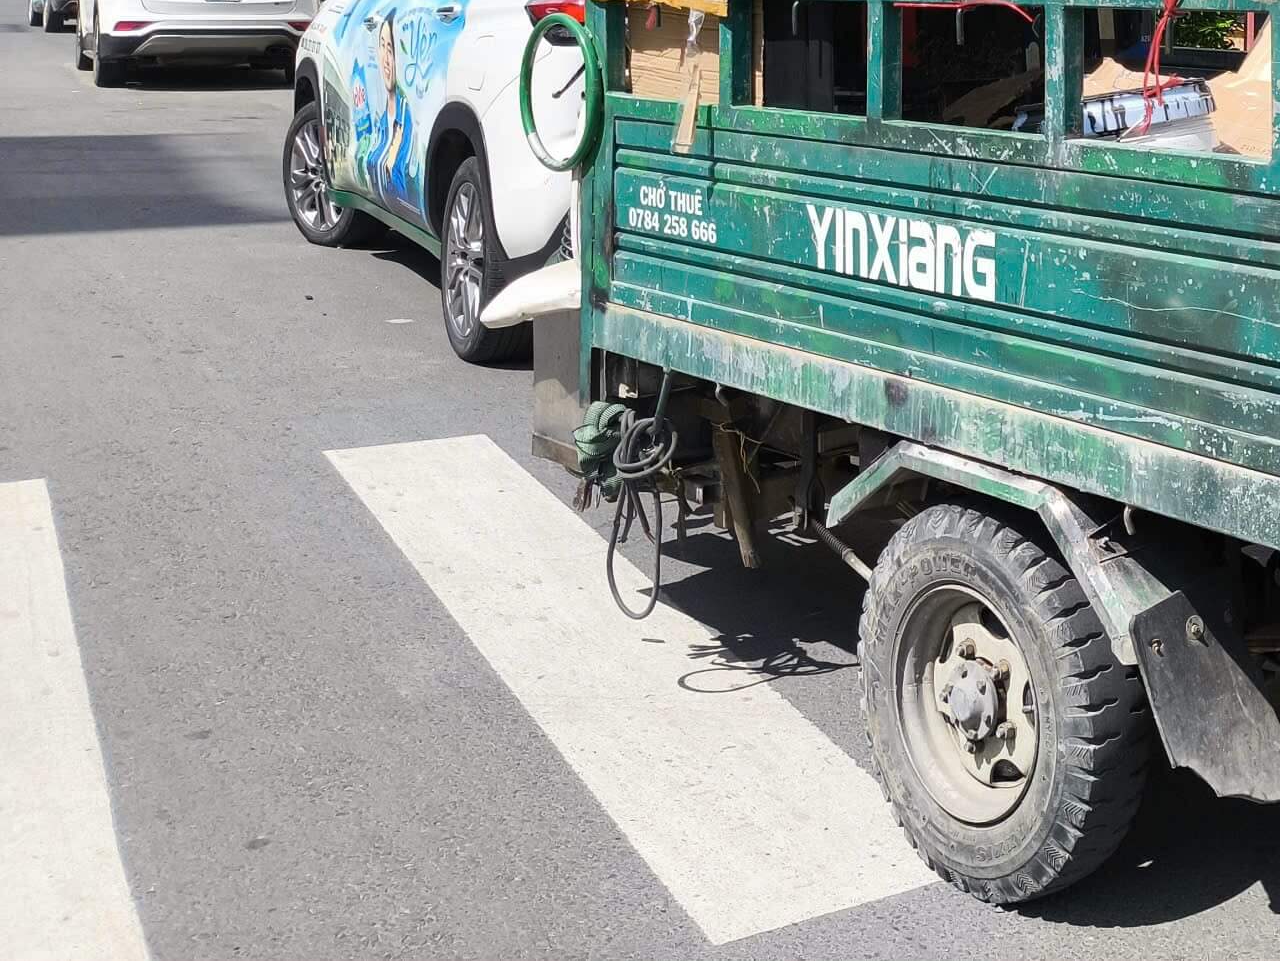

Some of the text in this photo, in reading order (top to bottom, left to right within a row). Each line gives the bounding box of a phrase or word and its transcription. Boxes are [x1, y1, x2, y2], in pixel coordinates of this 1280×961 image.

[668, 188, 703, 217] THUÊ
[628, 206, 718, 244] 0784 258 666
